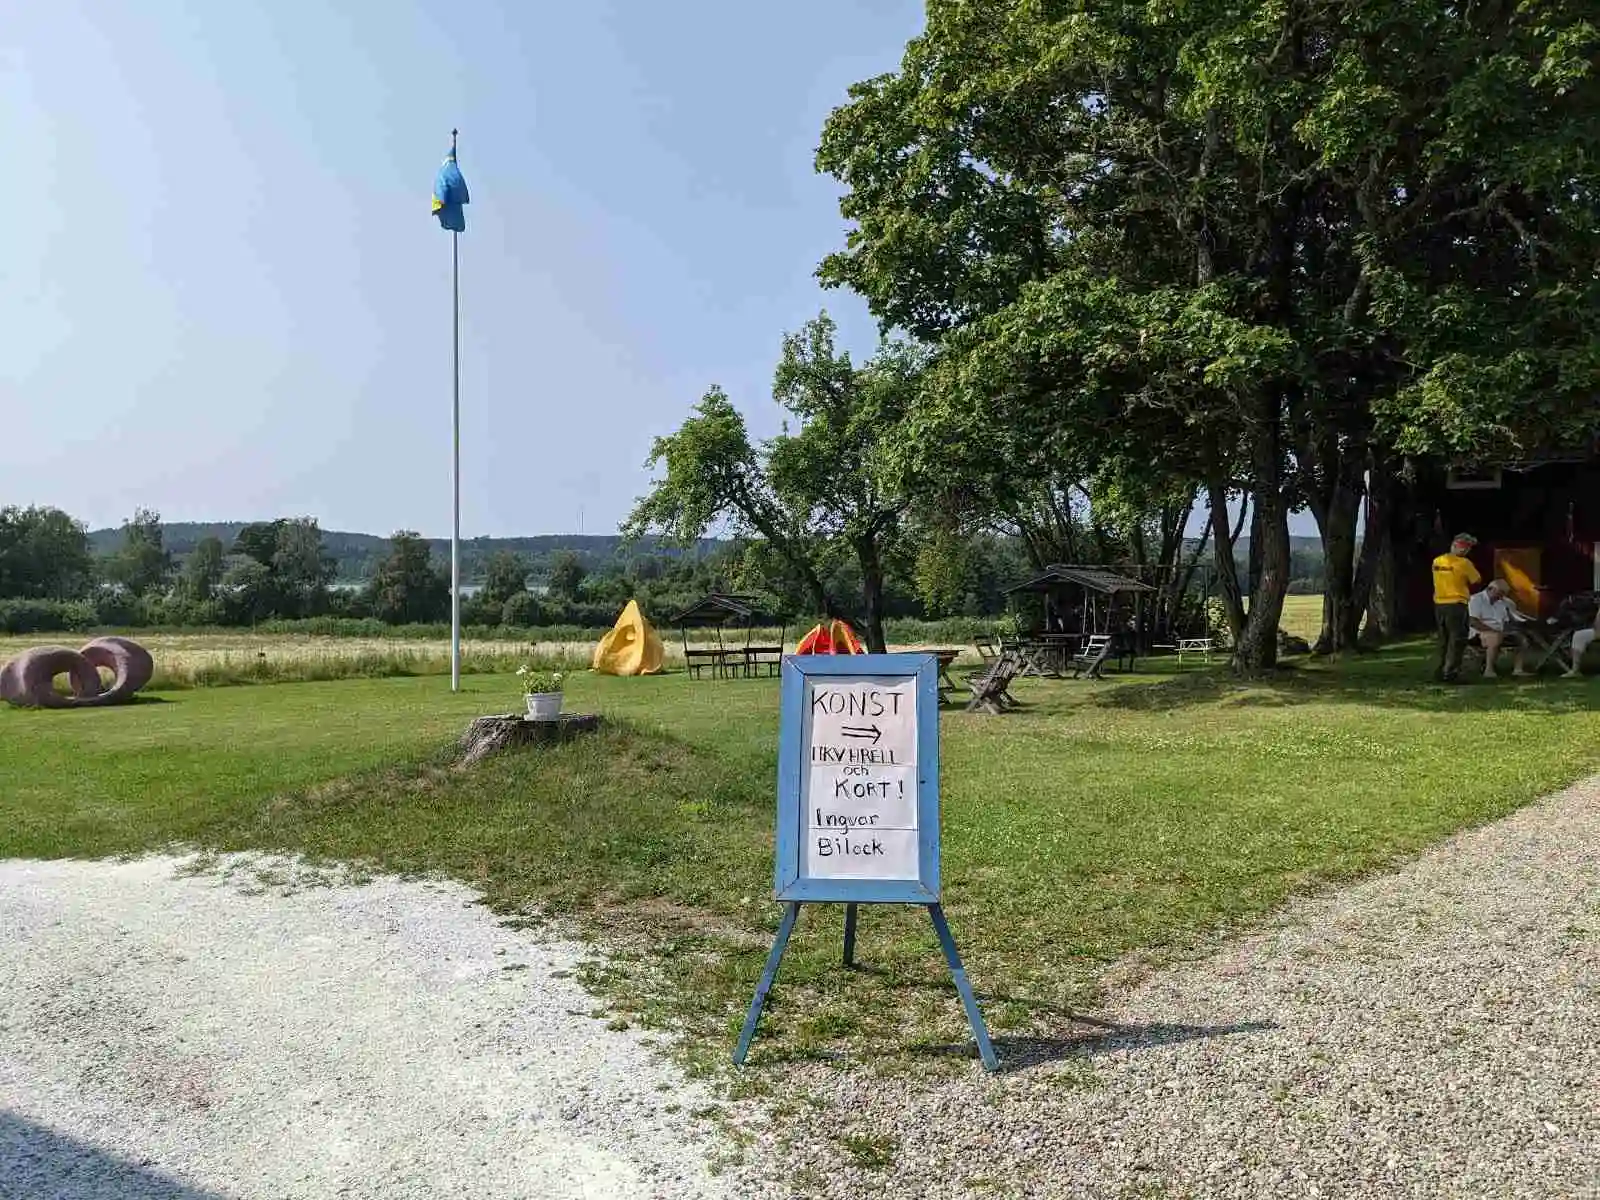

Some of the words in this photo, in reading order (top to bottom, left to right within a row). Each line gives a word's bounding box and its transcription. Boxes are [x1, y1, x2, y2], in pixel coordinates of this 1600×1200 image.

[811, 690, 904, 717] KONST
[843, 765, 869, 776] och
[816, 807, 879, 834] Ingvar
